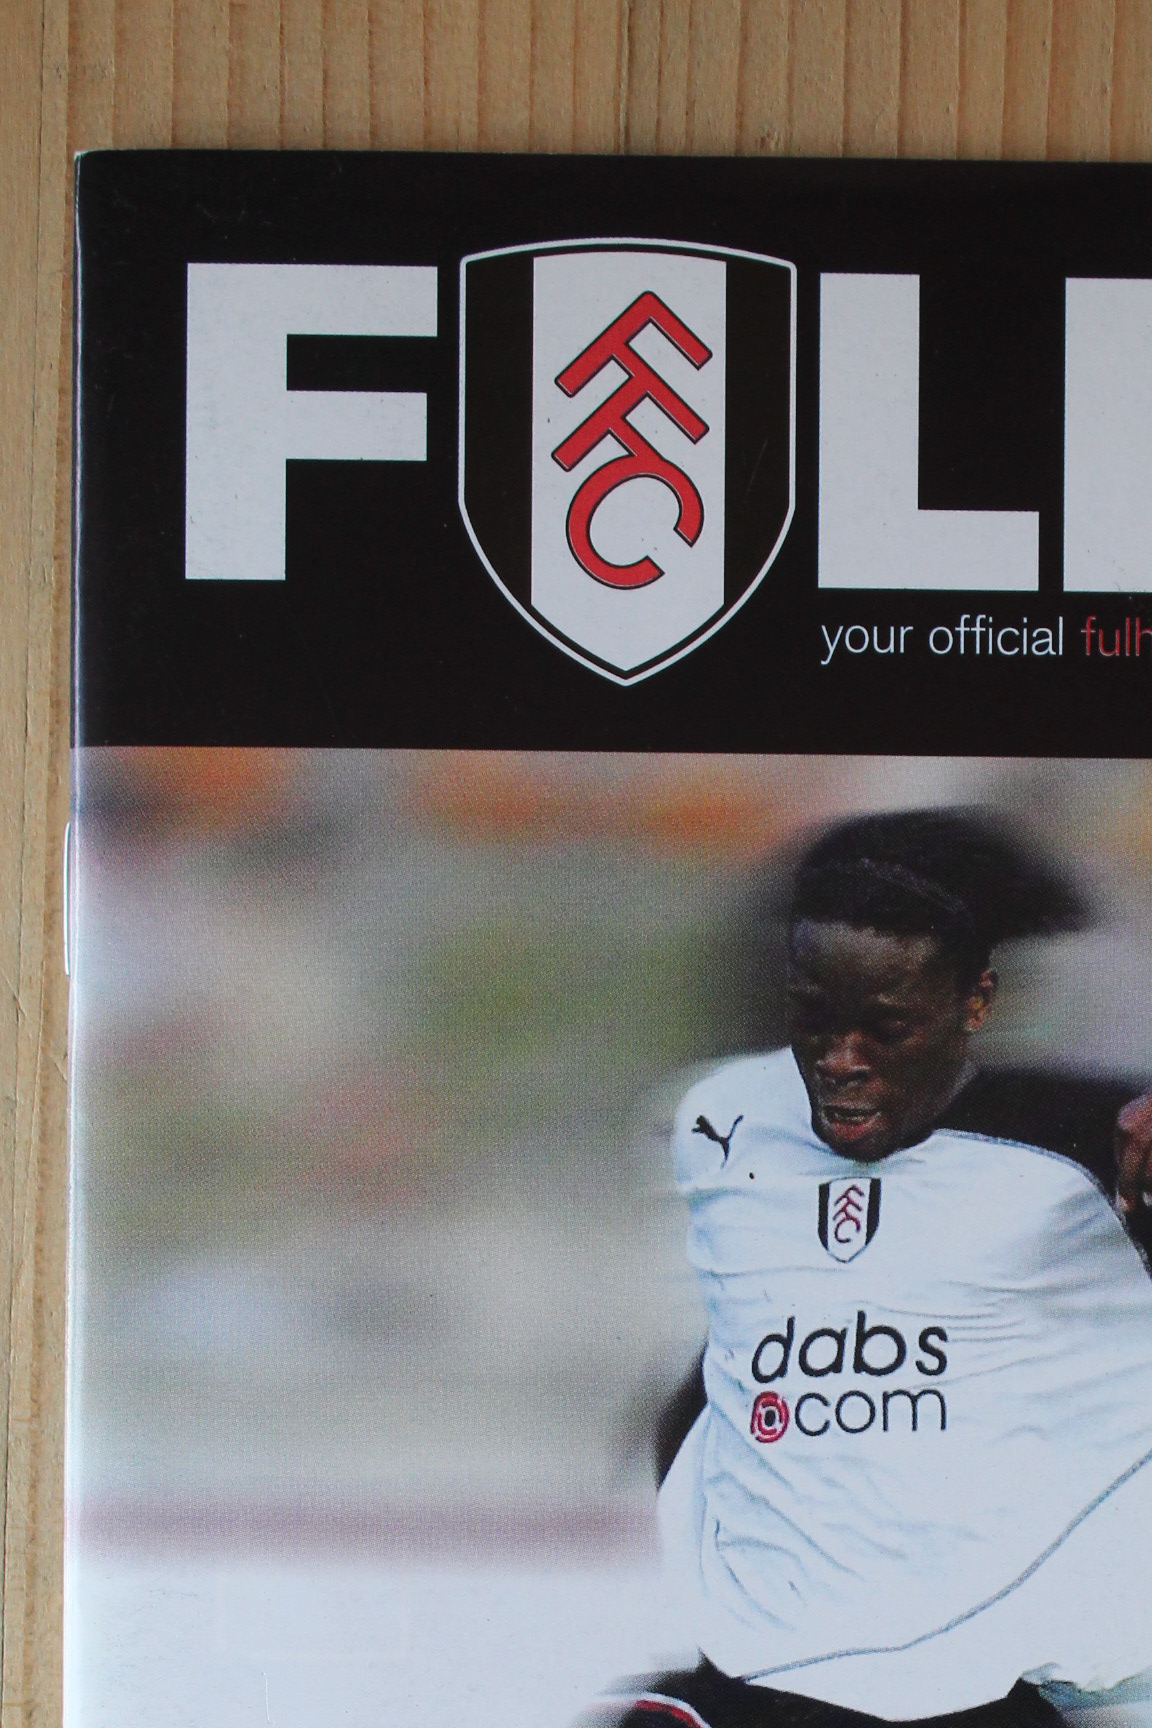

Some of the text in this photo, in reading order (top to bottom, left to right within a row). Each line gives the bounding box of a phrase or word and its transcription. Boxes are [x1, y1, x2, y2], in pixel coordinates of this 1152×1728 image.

[821, 625, 913, 666] your
[929, 614, 1064, 656] official
[750, 1310, 949, 1384] dabs
